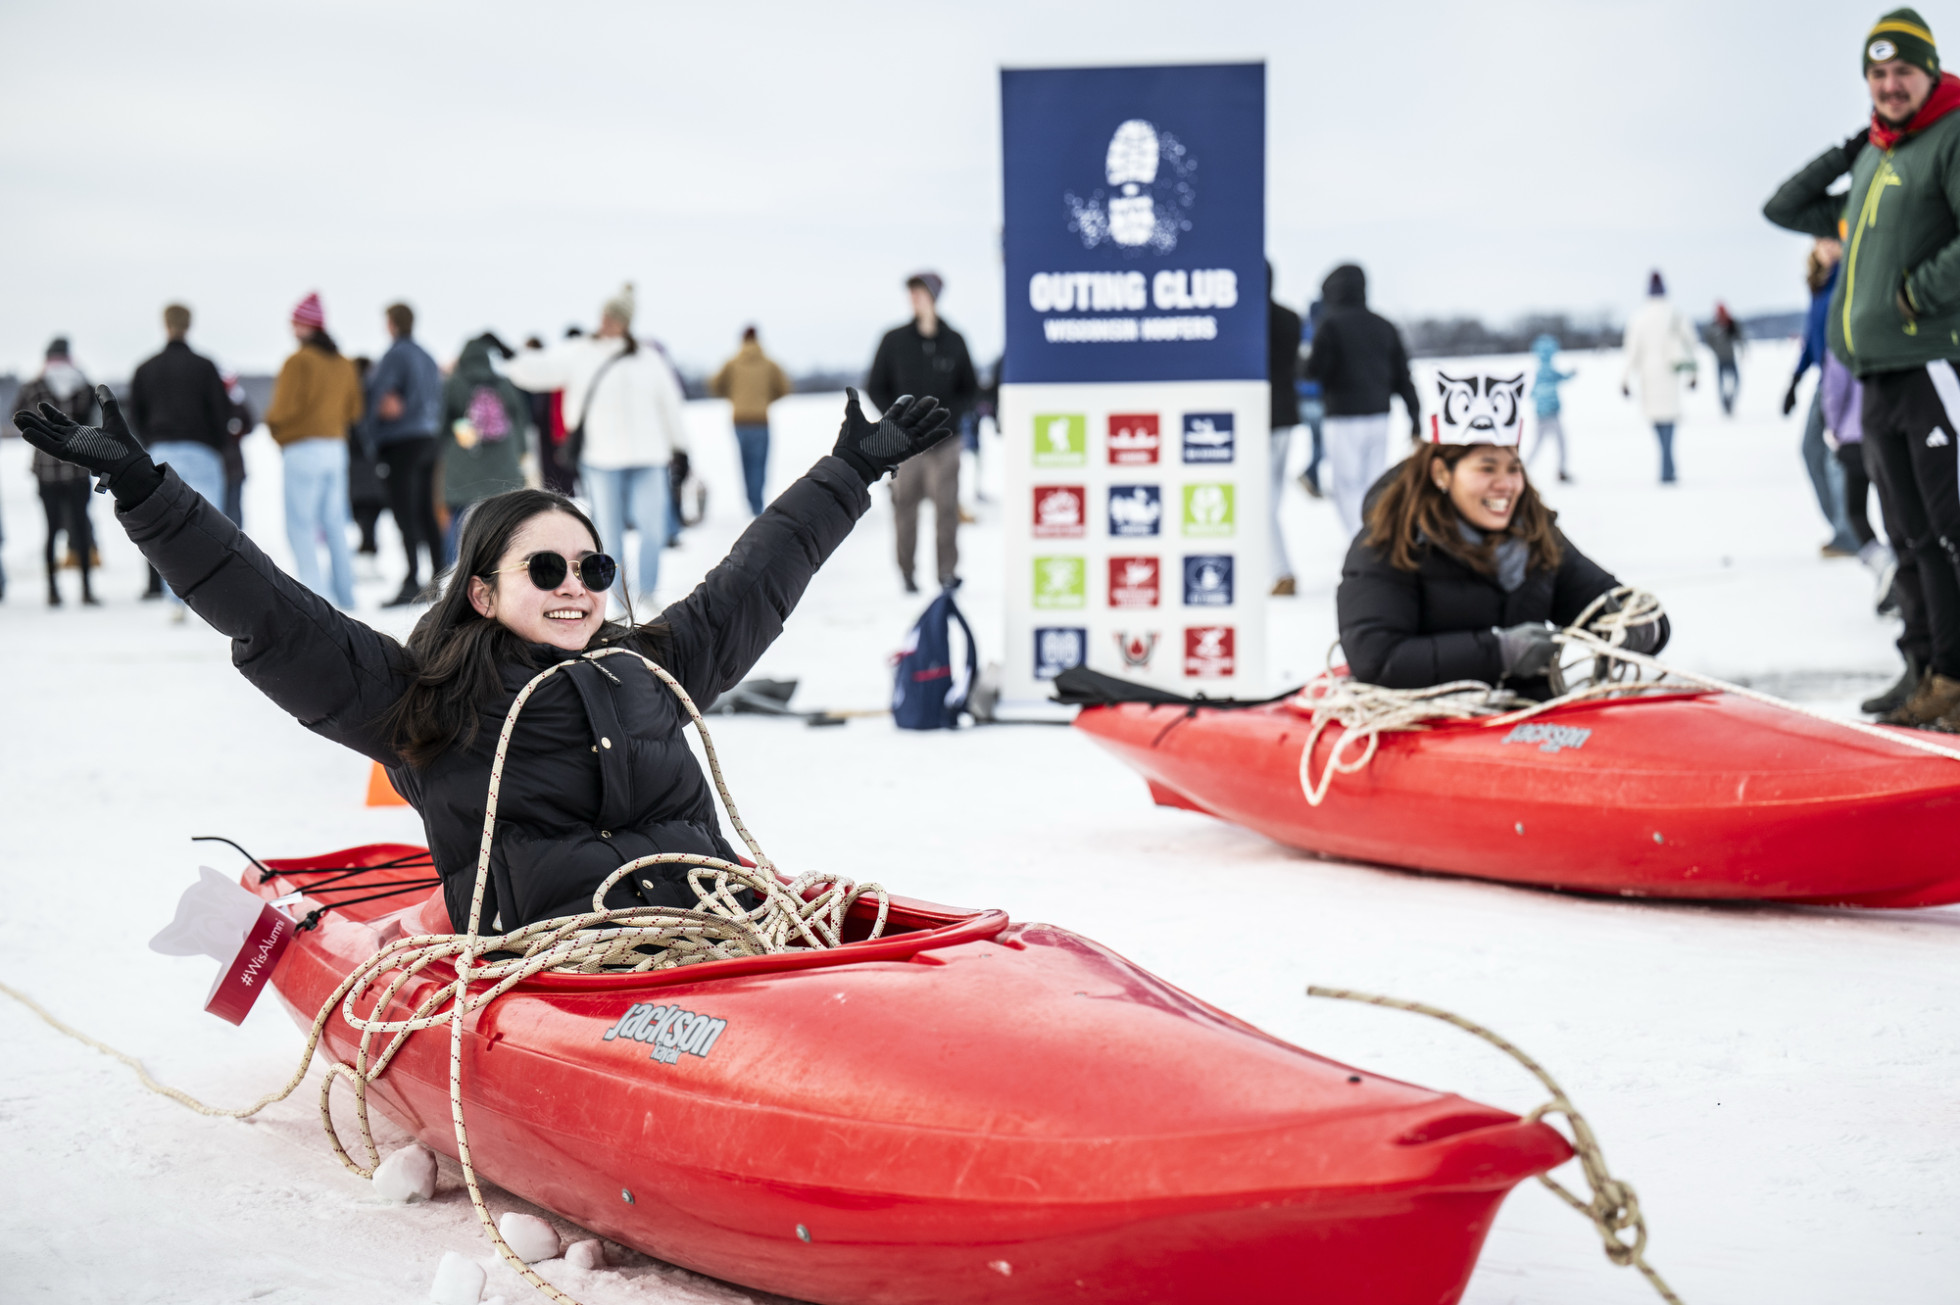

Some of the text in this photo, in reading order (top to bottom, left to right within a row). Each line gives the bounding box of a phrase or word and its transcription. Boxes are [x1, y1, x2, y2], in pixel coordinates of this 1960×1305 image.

[1029, 269, 1238, 312] OUTING CLUB
[240, 917, 285, 987] #WisAlumni
